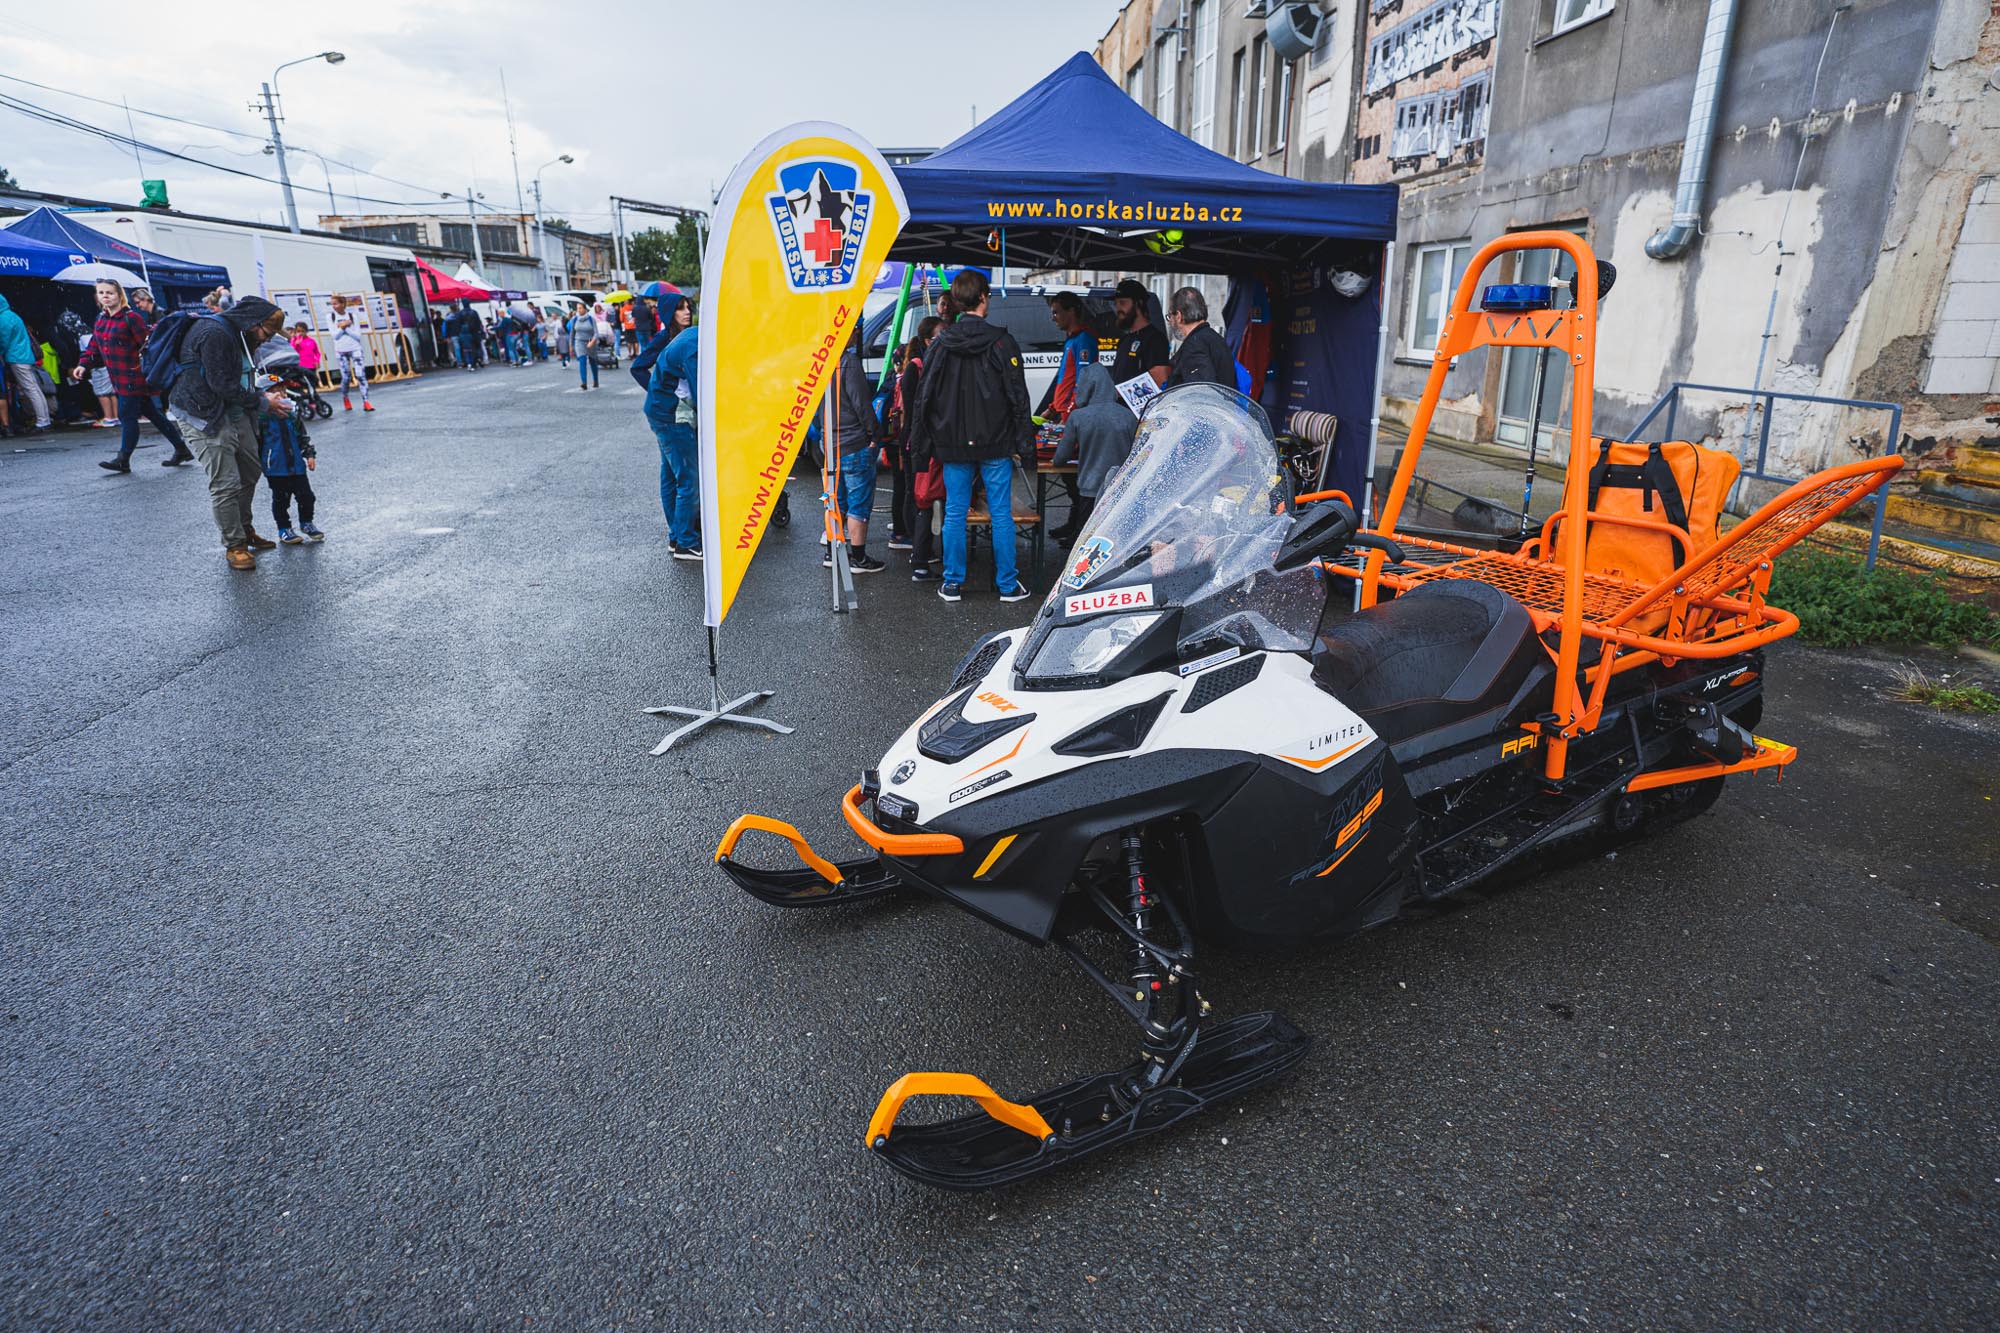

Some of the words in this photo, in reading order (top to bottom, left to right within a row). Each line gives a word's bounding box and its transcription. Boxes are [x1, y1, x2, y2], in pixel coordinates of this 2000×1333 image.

[987, 198, 1243, 222] www.horskasluzba.cz
[1022, 355, 1045, 365] NNÉ
[736, 303, 851, 551] www.horskasluzba.cz
[1070, 591, 1147, 613] SLUŽBA
[976, 691, 1020, 713] LYNX
[1309, 723, 1364, 751] LIMITED
